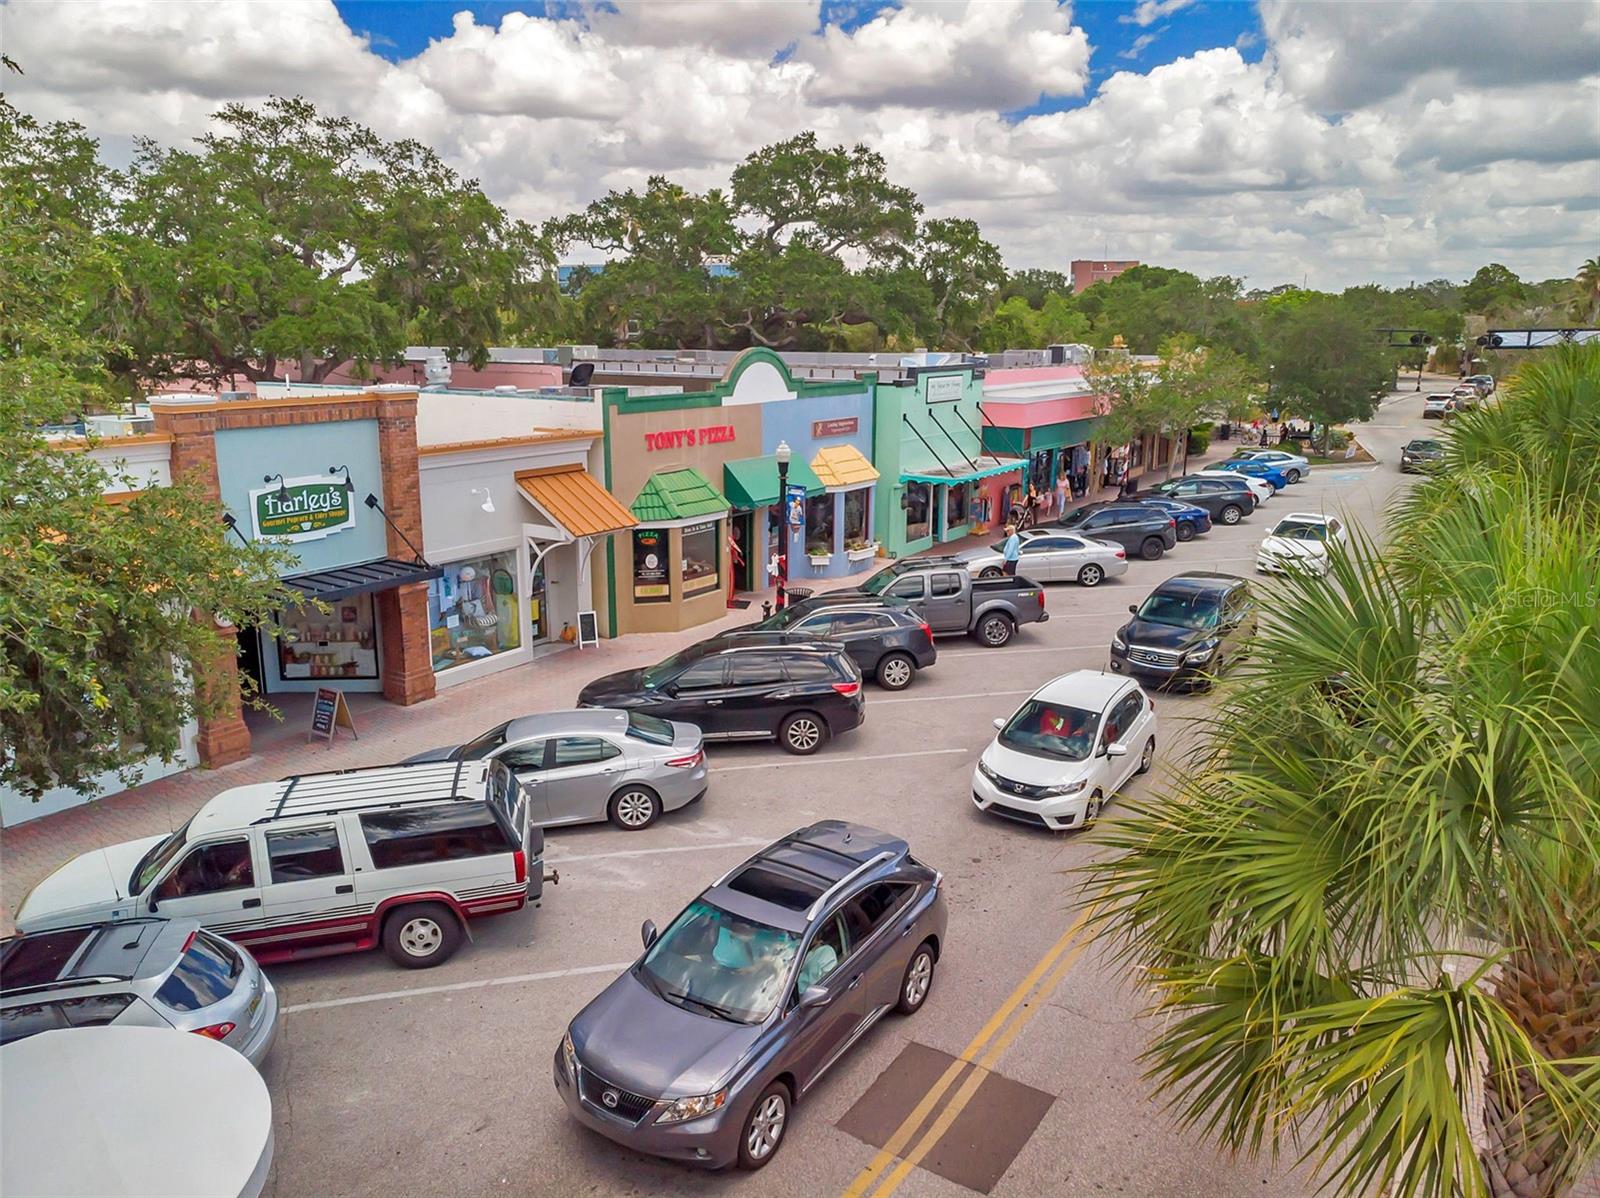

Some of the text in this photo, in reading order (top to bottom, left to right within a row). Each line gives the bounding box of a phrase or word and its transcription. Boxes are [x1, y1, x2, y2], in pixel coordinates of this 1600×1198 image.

[645, 425, 735, 452] TONY'S PIZZA
[264, 486, 342, 512] Harley's
[262, 518, 286, 527] Gourmet
[286, 515, 308, 523] Popcorn
[638, 531, 658, 539] PIZZA
